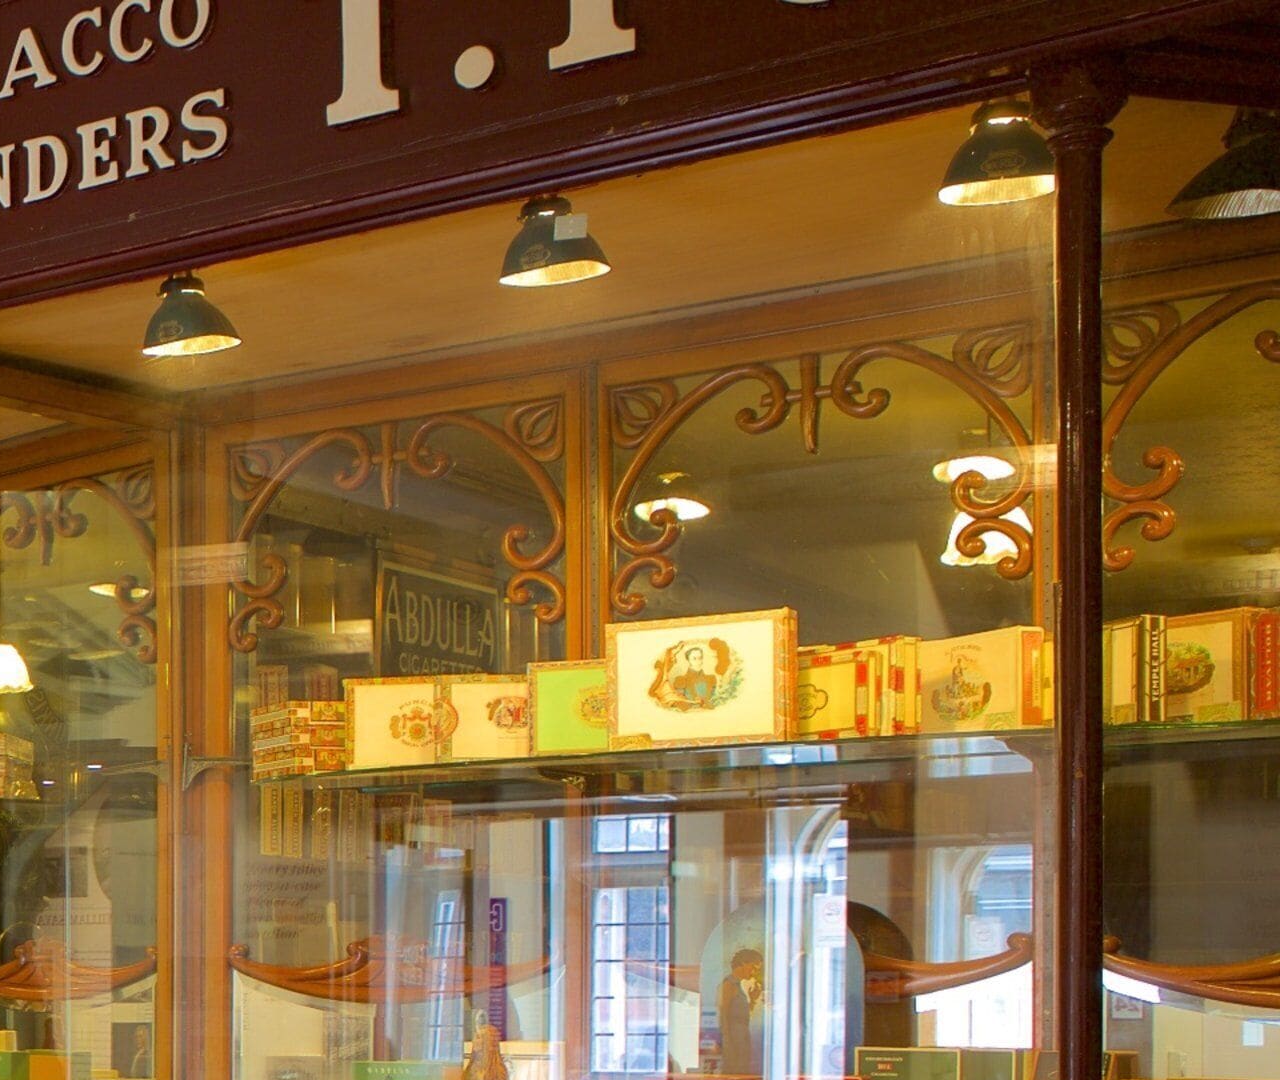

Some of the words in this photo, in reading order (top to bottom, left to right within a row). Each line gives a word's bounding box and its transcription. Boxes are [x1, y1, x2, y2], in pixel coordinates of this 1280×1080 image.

[385, 574, 495, 661] ABDULLA
[1151, 628, 1161, 656] HALL
[1151, 657, 1161, 703] TEMPLE
